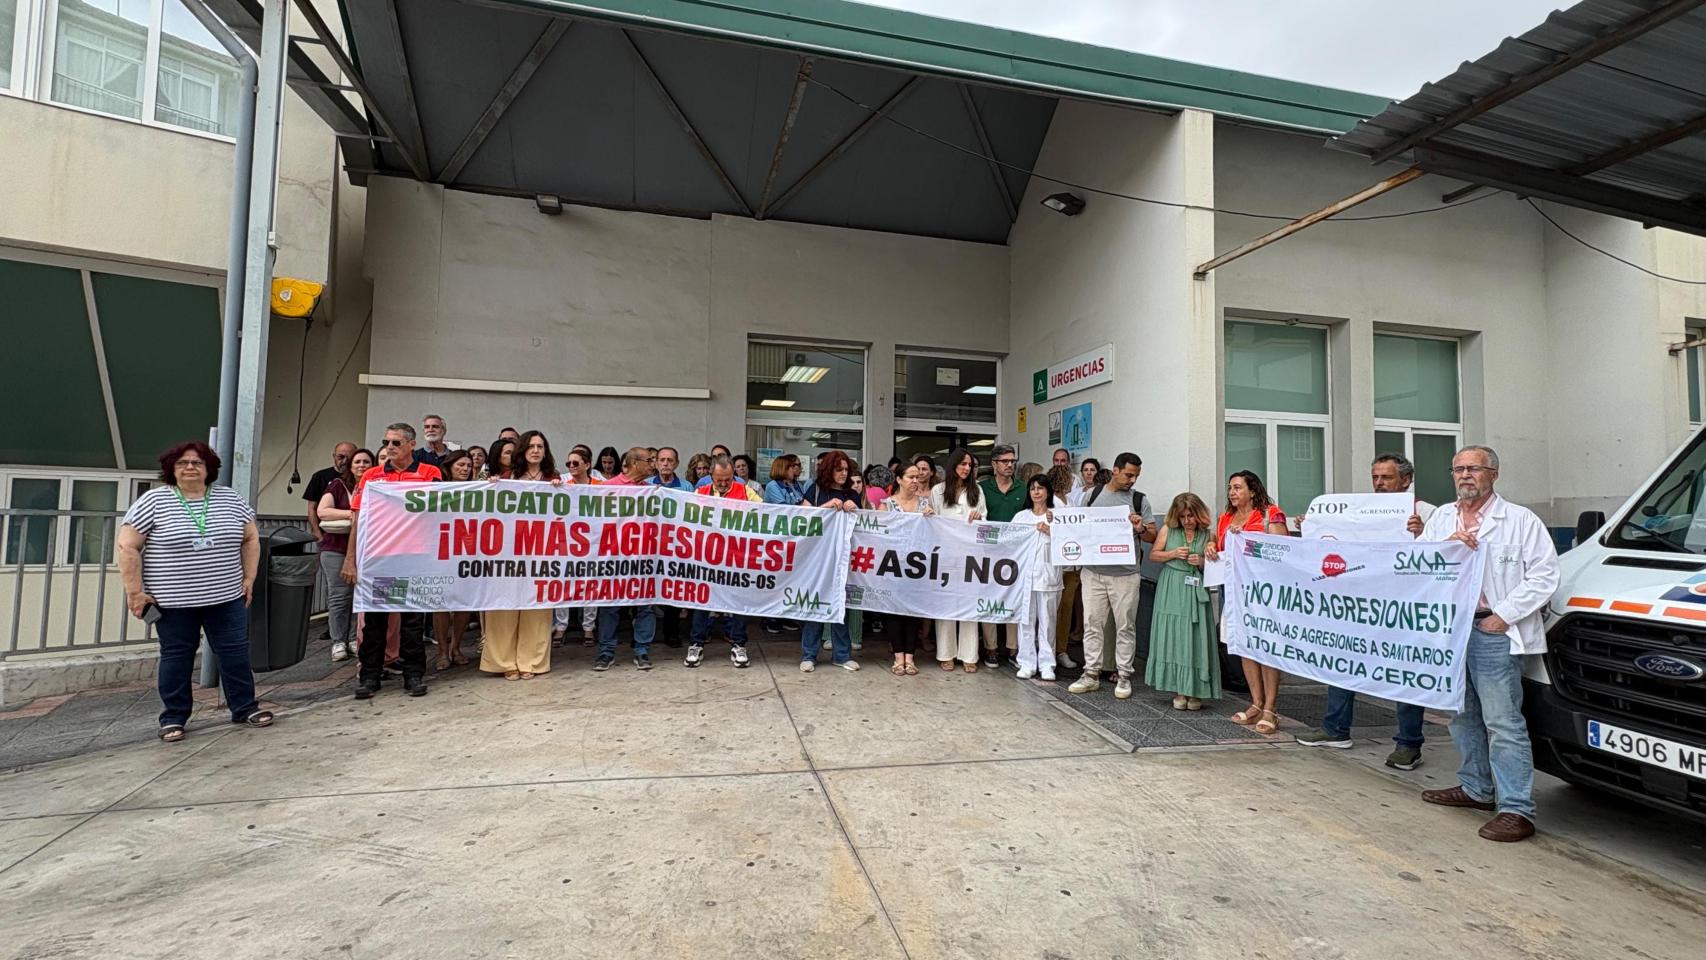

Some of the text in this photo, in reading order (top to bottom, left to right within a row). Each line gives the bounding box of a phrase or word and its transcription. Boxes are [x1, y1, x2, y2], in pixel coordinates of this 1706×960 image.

[1051, 357, 1105, 389] URGENCIAS
[404, 489, 824, 537] SINDICATO MÉDICO DE MÁLAGA
[1054, 514, 1086, 525] STOP
[1308, 502, 1349, 515] STOP
[437, 517, 797, 572] ¡NO MÁS AGRESIONES!
[411, 575, 455, 585] SINDICATO
[458, 558, 776, 590] CONTRA LAS AGRESIONES A SANITARIAS-OS
[850, 546, 1020, 588] #ASÍ, NO
[1323, 561, 1346, 570] STOP
[534, 577, 710, 605] TOLERANCIA CERO
[1276, 583, 1315, 615] MÁS
[1317, 592, 1457, 634] AGRESIONES!!
[1299, 627, 1368, 655] AGRESIONES
[1370, 639, 1380, 657] A
[1381, 642, 1454, 667] SANITARIOS
[1371, 666, 1452, 693] CERO!!
[1644, 655, 1684, 676] Ford
[1604, 729, 1668, 763] 4906
